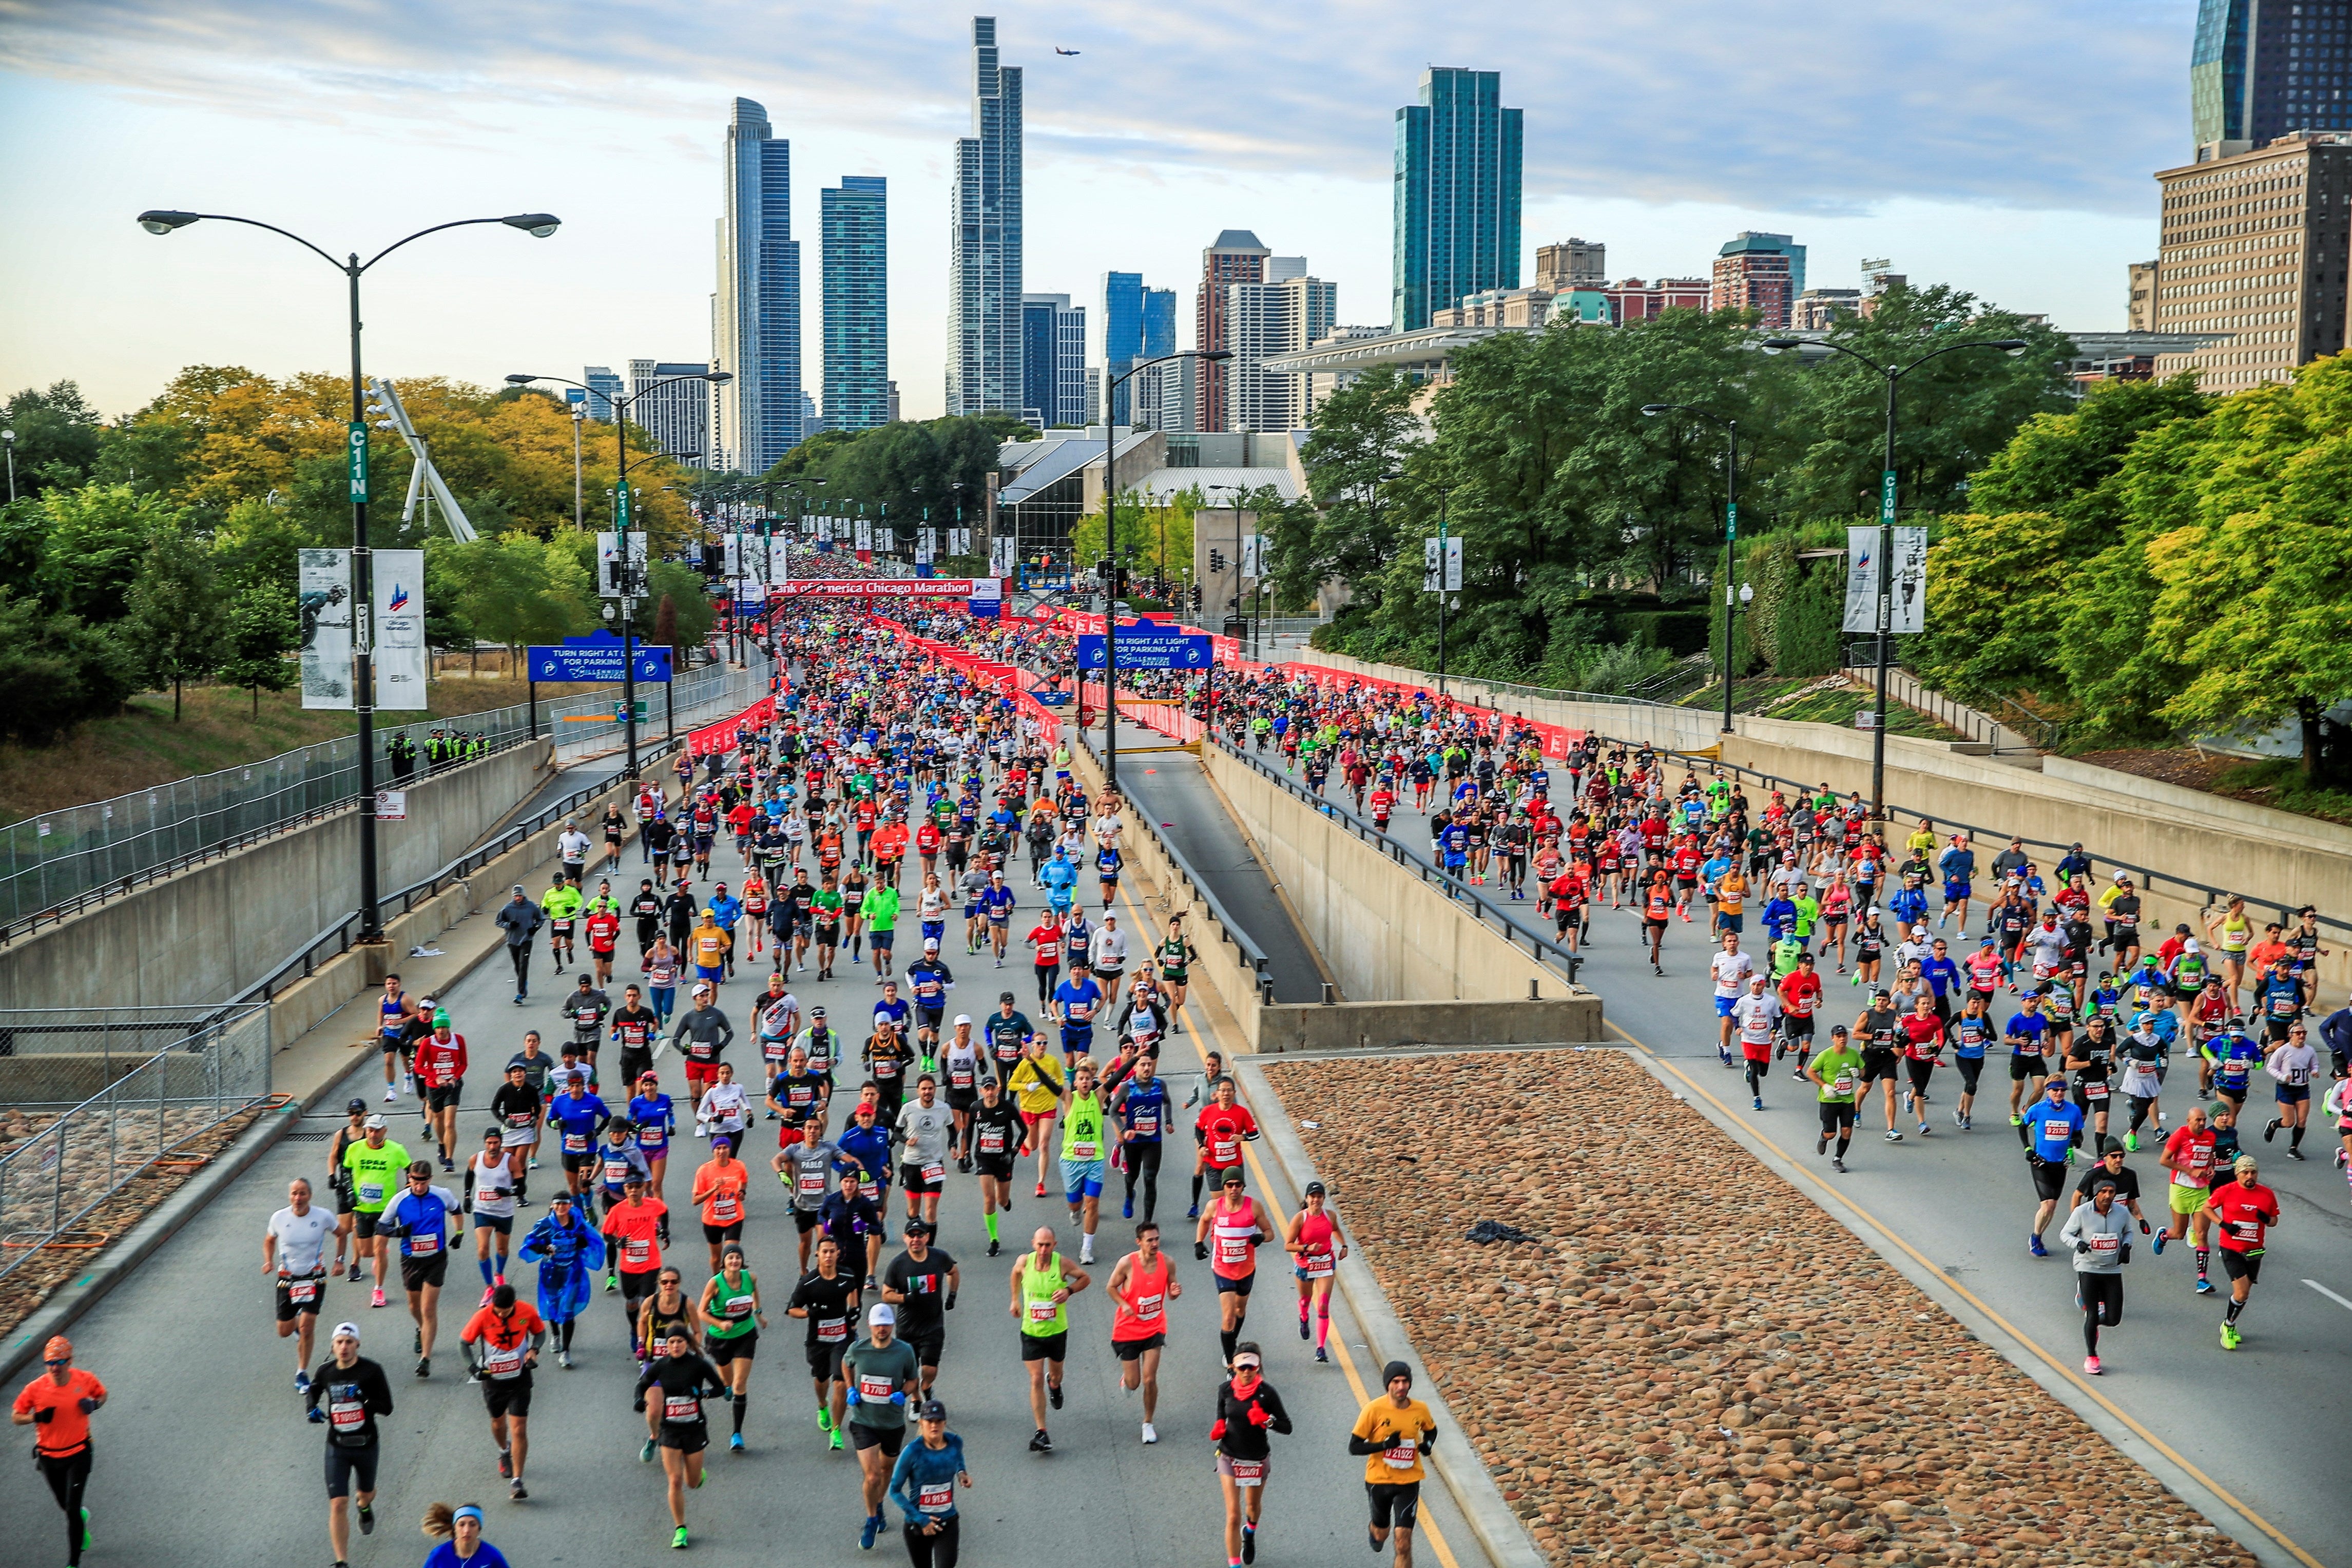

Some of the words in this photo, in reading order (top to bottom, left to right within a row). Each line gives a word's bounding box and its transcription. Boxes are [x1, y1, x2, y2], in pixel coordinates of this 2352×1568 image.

[815, 583, 863, 593] America
[865, 582, 912, 595] Chicago
[914, 582, 970, 593] Marathon
[356, 606, 368, 653] C11N
[801, 1159, 823, 1169] PABLO
[864, 1383, 870, 1393] D
